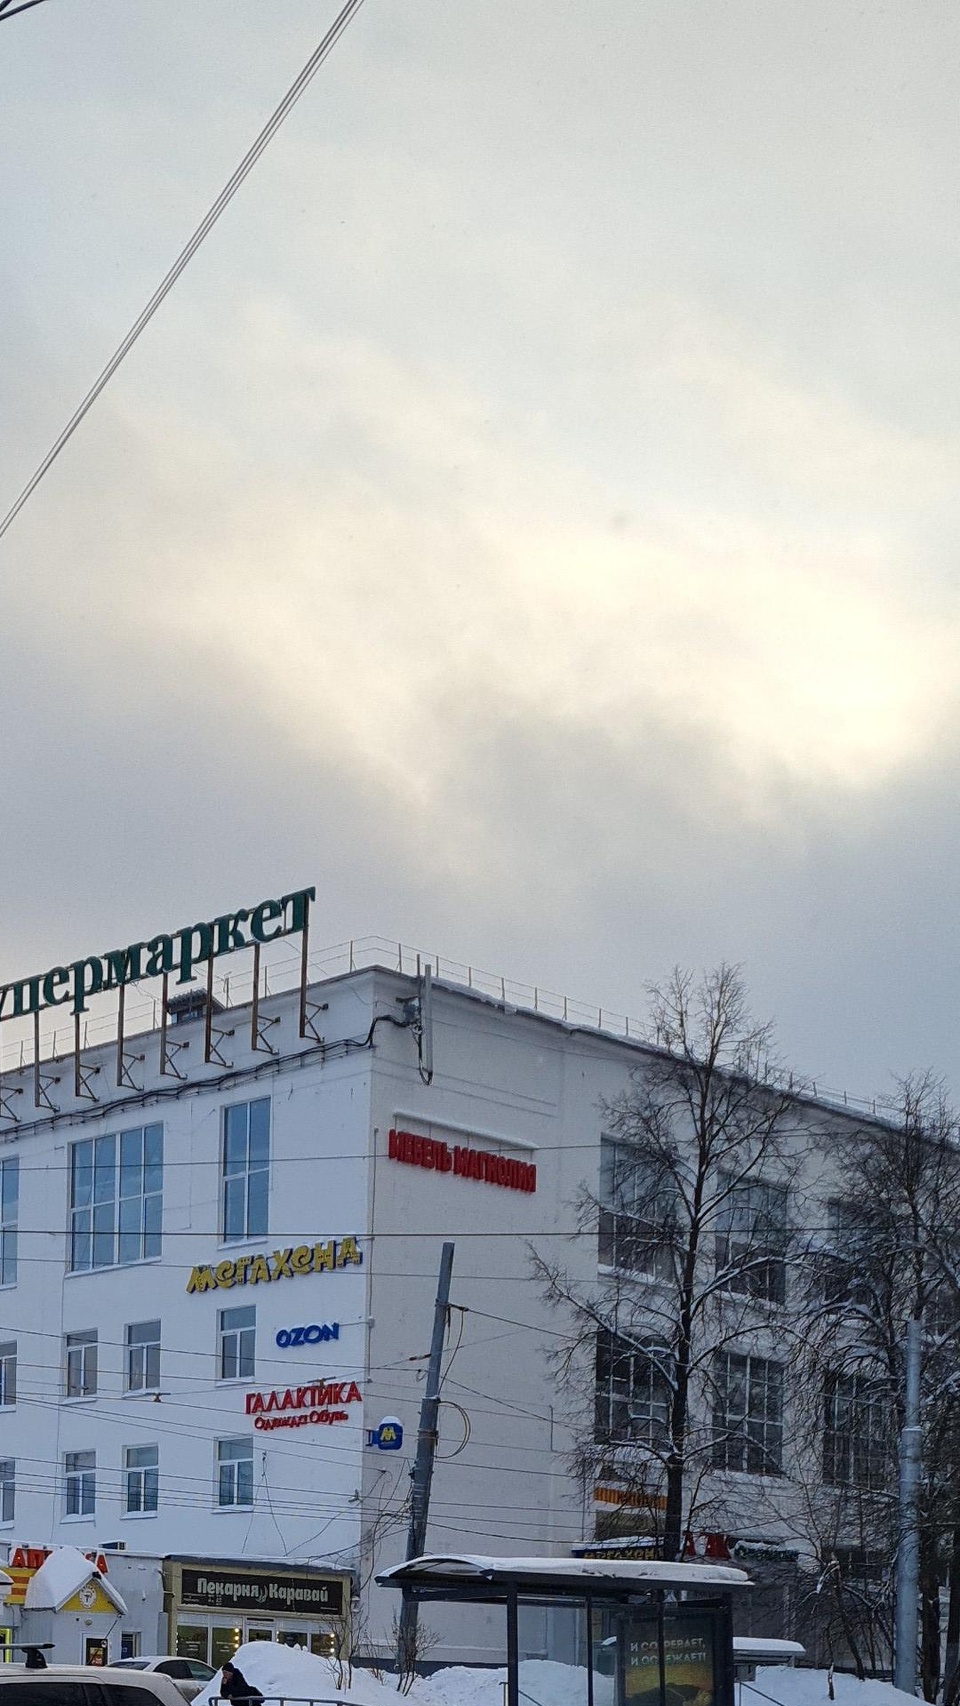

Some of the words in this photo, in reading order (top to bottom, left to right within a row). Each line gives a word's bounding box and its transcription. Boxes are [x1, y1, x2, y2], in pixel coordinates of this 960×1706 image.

[388, 1129, 452, 1172] МЕБЕЛЬ
[275, 1322, 340, 1348] OZON
[245, 1381, 363, 1414] ГАЛАКТИКА
[11, 1547, 109, 1574] АПА
[197, 1578, 260, 1601] Пекарня
[269, 1583, 329, 1606] Каравай
[641, 1637, 706, 1651] СОРЕВАЕТ,
[641, 1652, 706, 1665] ОСЕЖАЕТ!
